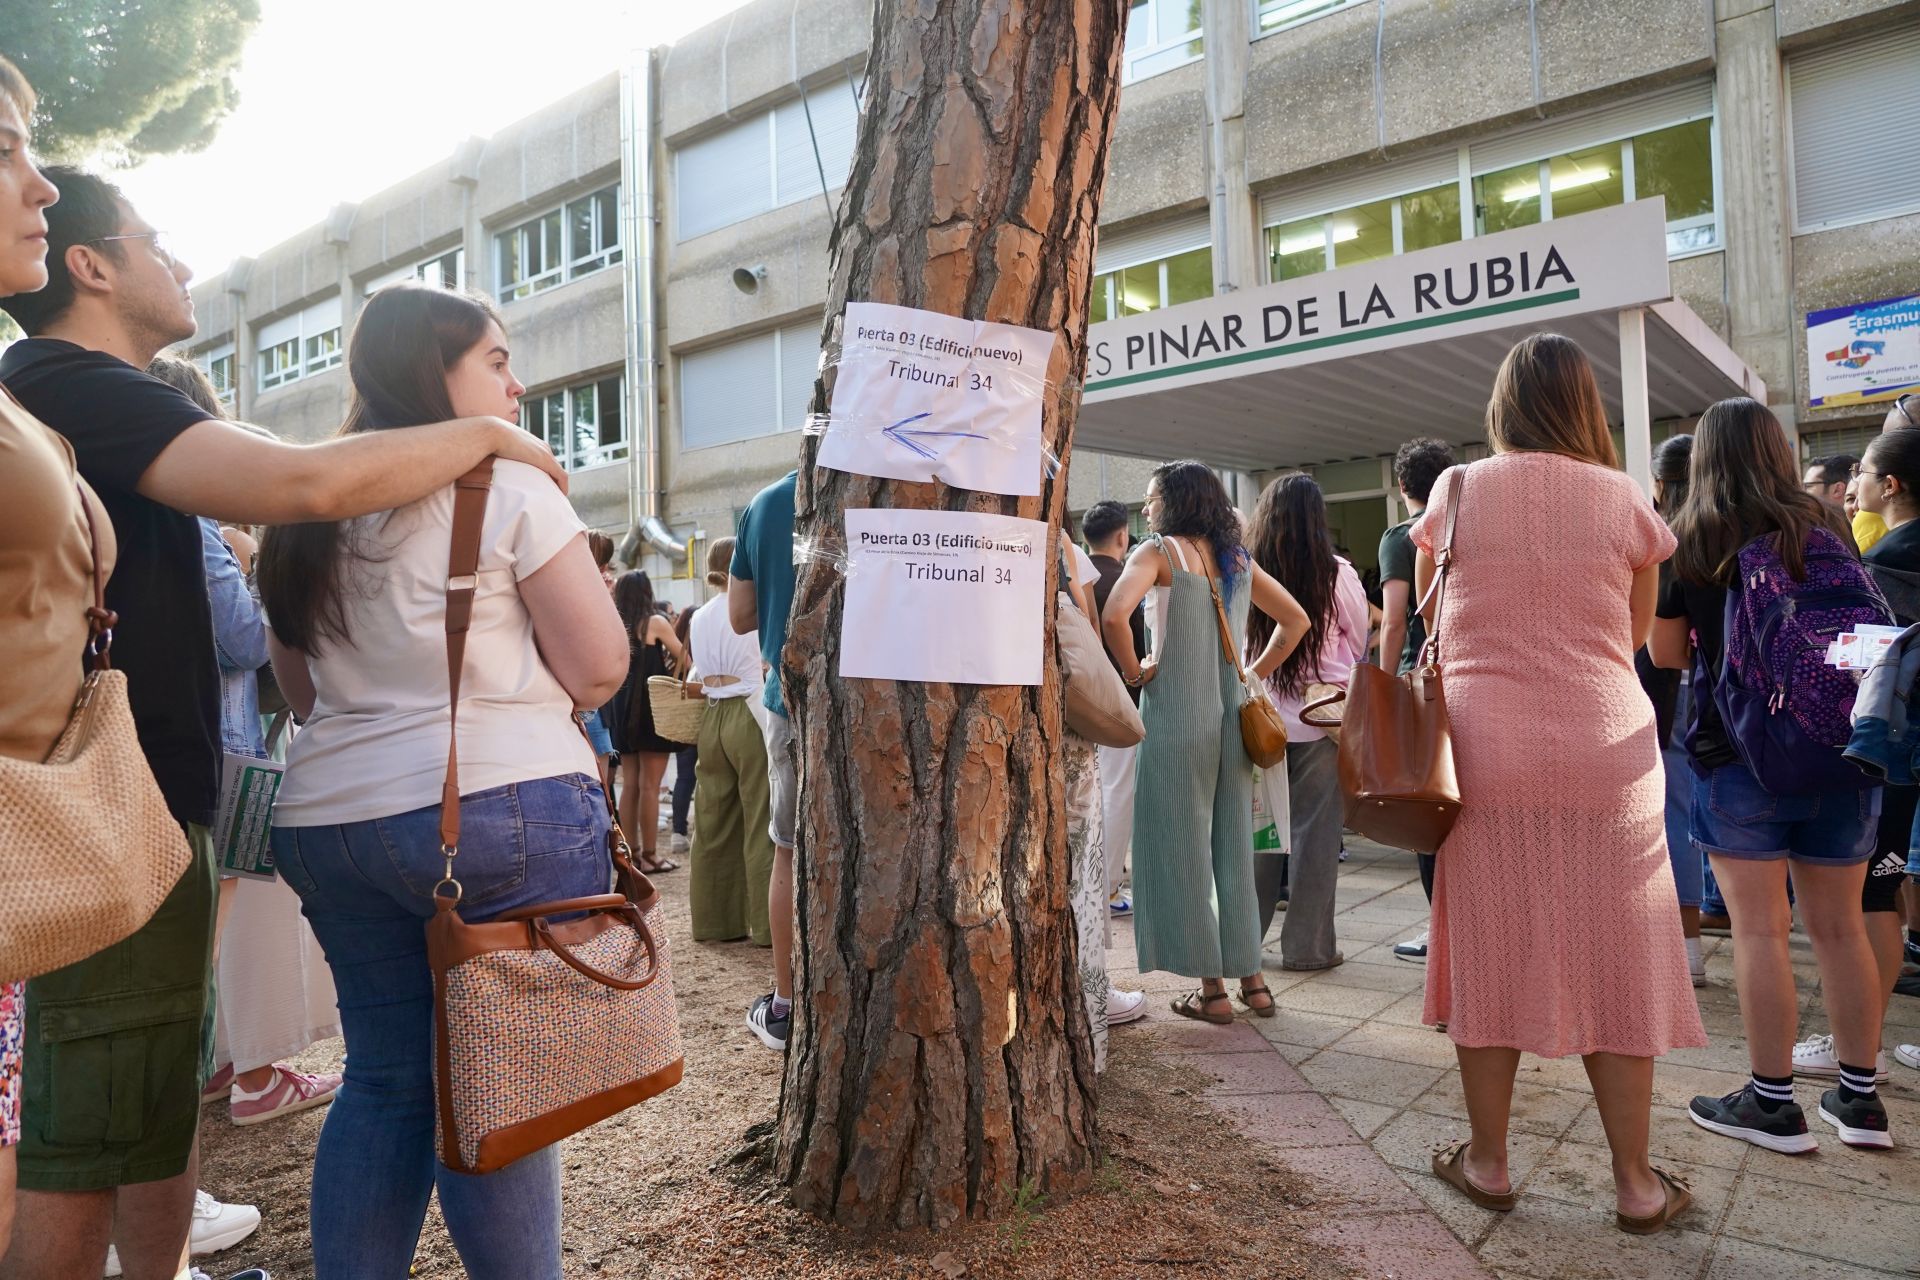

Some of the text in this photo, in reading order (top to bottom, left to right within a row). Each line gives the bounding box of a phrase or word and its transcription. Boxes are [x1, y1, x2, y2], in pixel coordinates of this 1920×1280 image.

[1125, 314, 1246, 370] PINAR
[1263, 297, 1319, 344] DE
[1339, 283, 1395, 328] LA
[1414, 244, 1575, 313] RUBIA
[1857, 310, 1920, 329] Erasmu
[899, 331, 916, 346] 03
[973, 346, 1023, 366] nuevo)
[888, 360, 993, 391] Tribunal 34
[861, 532, 908, 546] Puerta
[912, 533, 931, 546] 03
[935, 533, 993, 550] (Edificio
[905, 562, 1012, 585] Tribunal 34
[1872, 865, 1905, 877] adida
